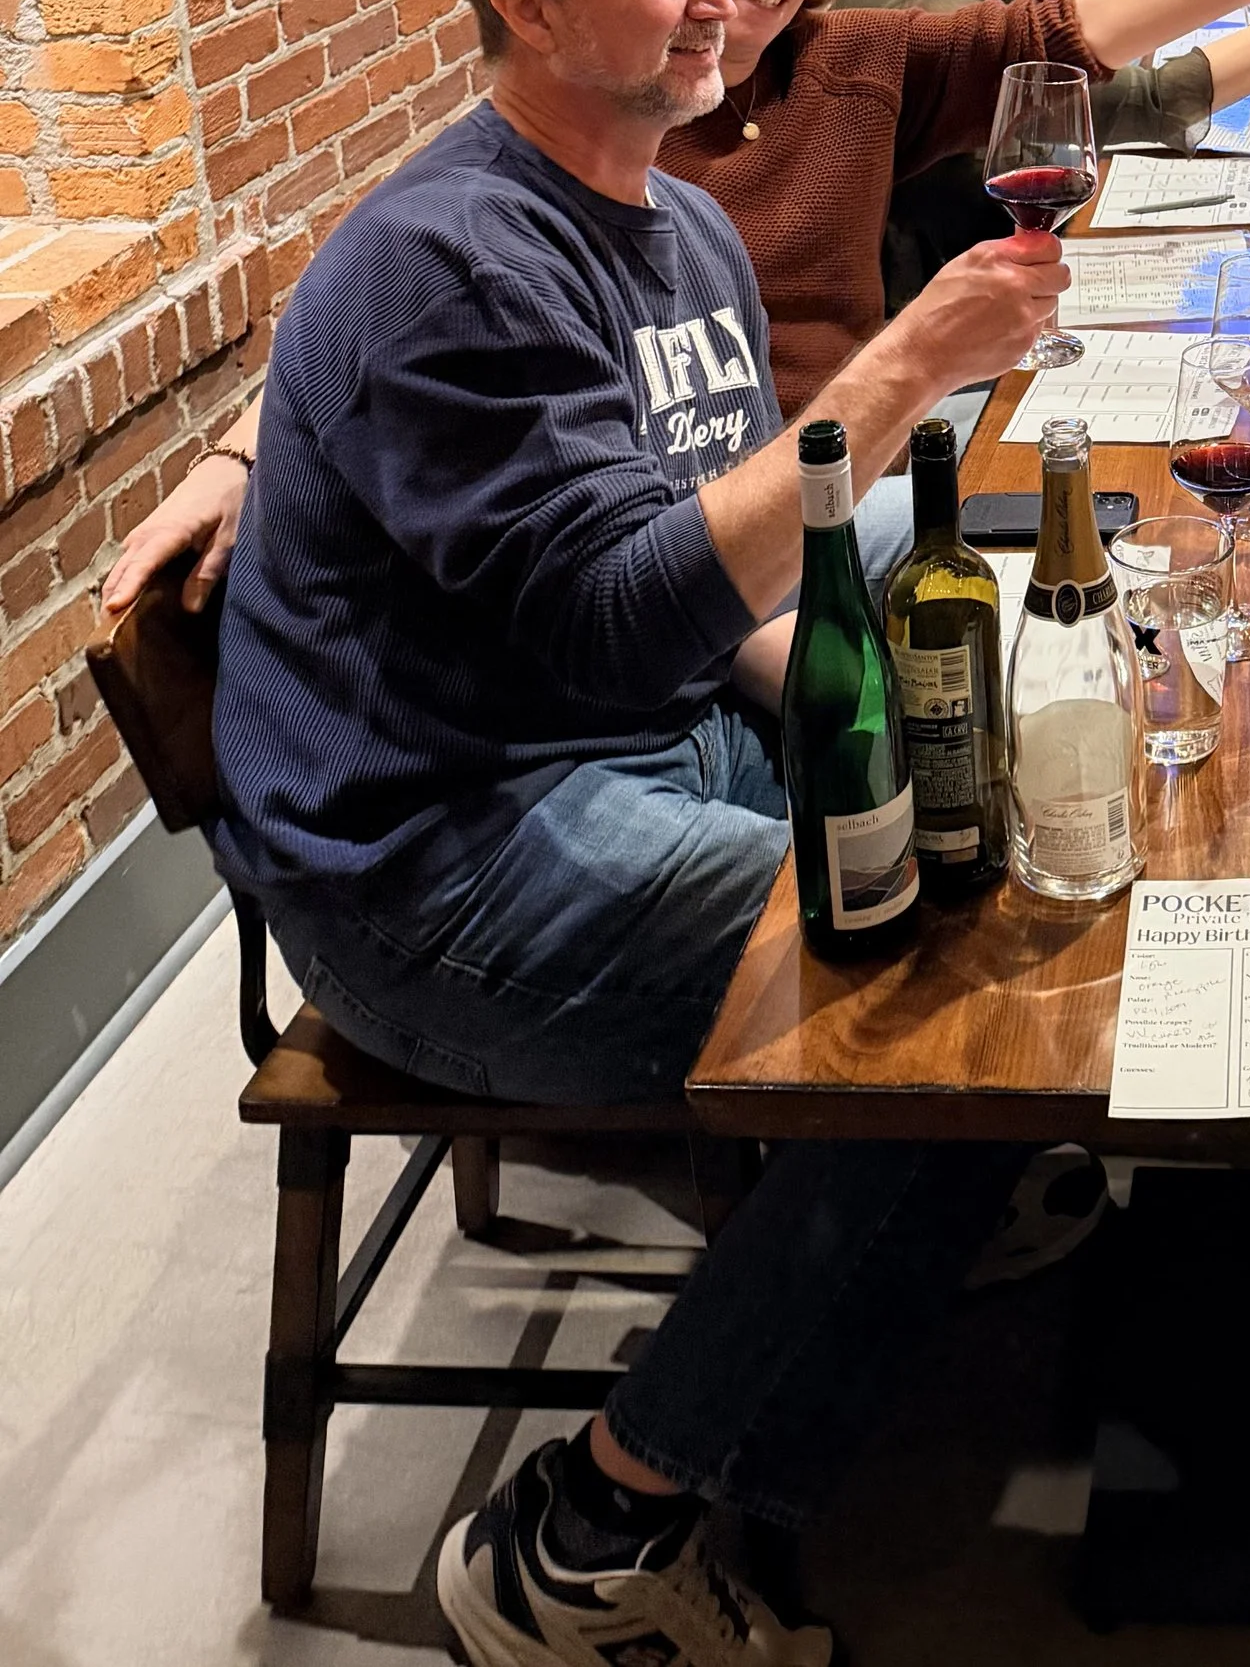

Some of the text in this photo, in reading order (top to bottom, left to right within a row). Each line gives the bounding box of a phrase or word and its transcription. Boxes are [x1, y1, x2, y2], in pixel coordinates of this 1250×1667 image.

[837, 814, 880, 831] selbach
[1173, 912, 1241, 925] Private
[1137, 927, 1201, 945] Happy
[1125, 1018, 1193, 1027] Possible Grapes?
[1122, 1041, 1169, 1049] Traditional
[1180, 1041, 1217, 1049] Modern?
